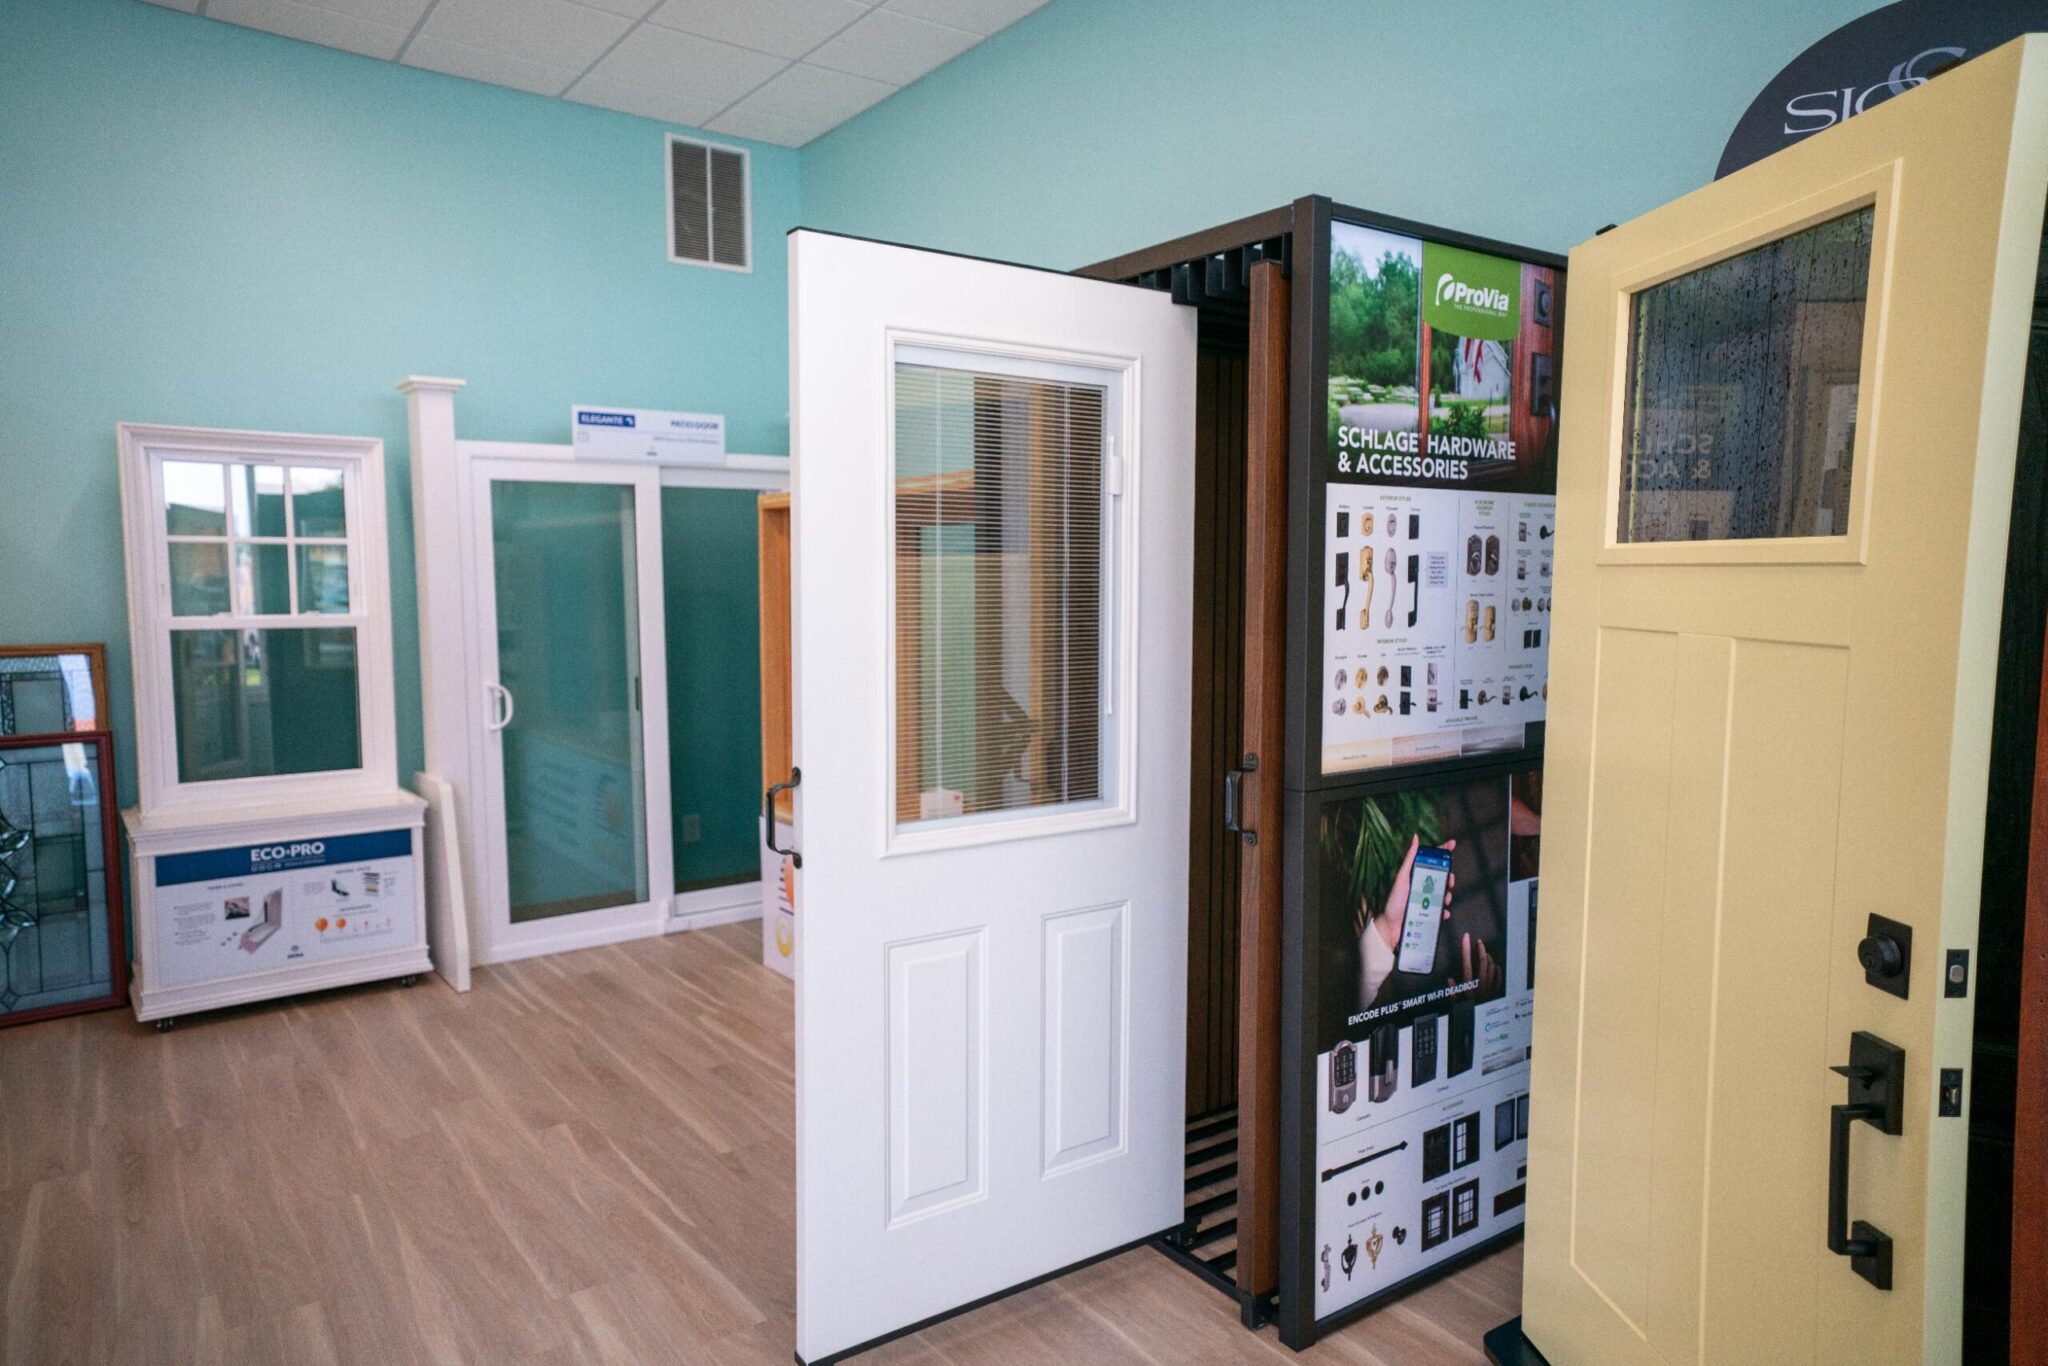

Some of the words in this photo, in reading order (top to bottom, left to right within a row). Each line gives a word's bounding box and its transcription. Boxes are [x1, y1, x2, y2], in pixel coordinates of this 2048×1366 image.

[1455, 282, 1509, 311] ProVia
[581, 414, 623, 426] ELEGANTE
[1427, 434, 1516, 460] HARDWARE
[1338, 451, 1351, 473] &
[1356, 453, 1468, 481] ACCESSORIES
[1348, 1008, 1379, 1025] ENCODE
[1402, 994, 1426, 1010] SMART
[1427, 989, 1444, 1002] WI-FI
[1445, 979, 1479, 997] DEADBOLT
